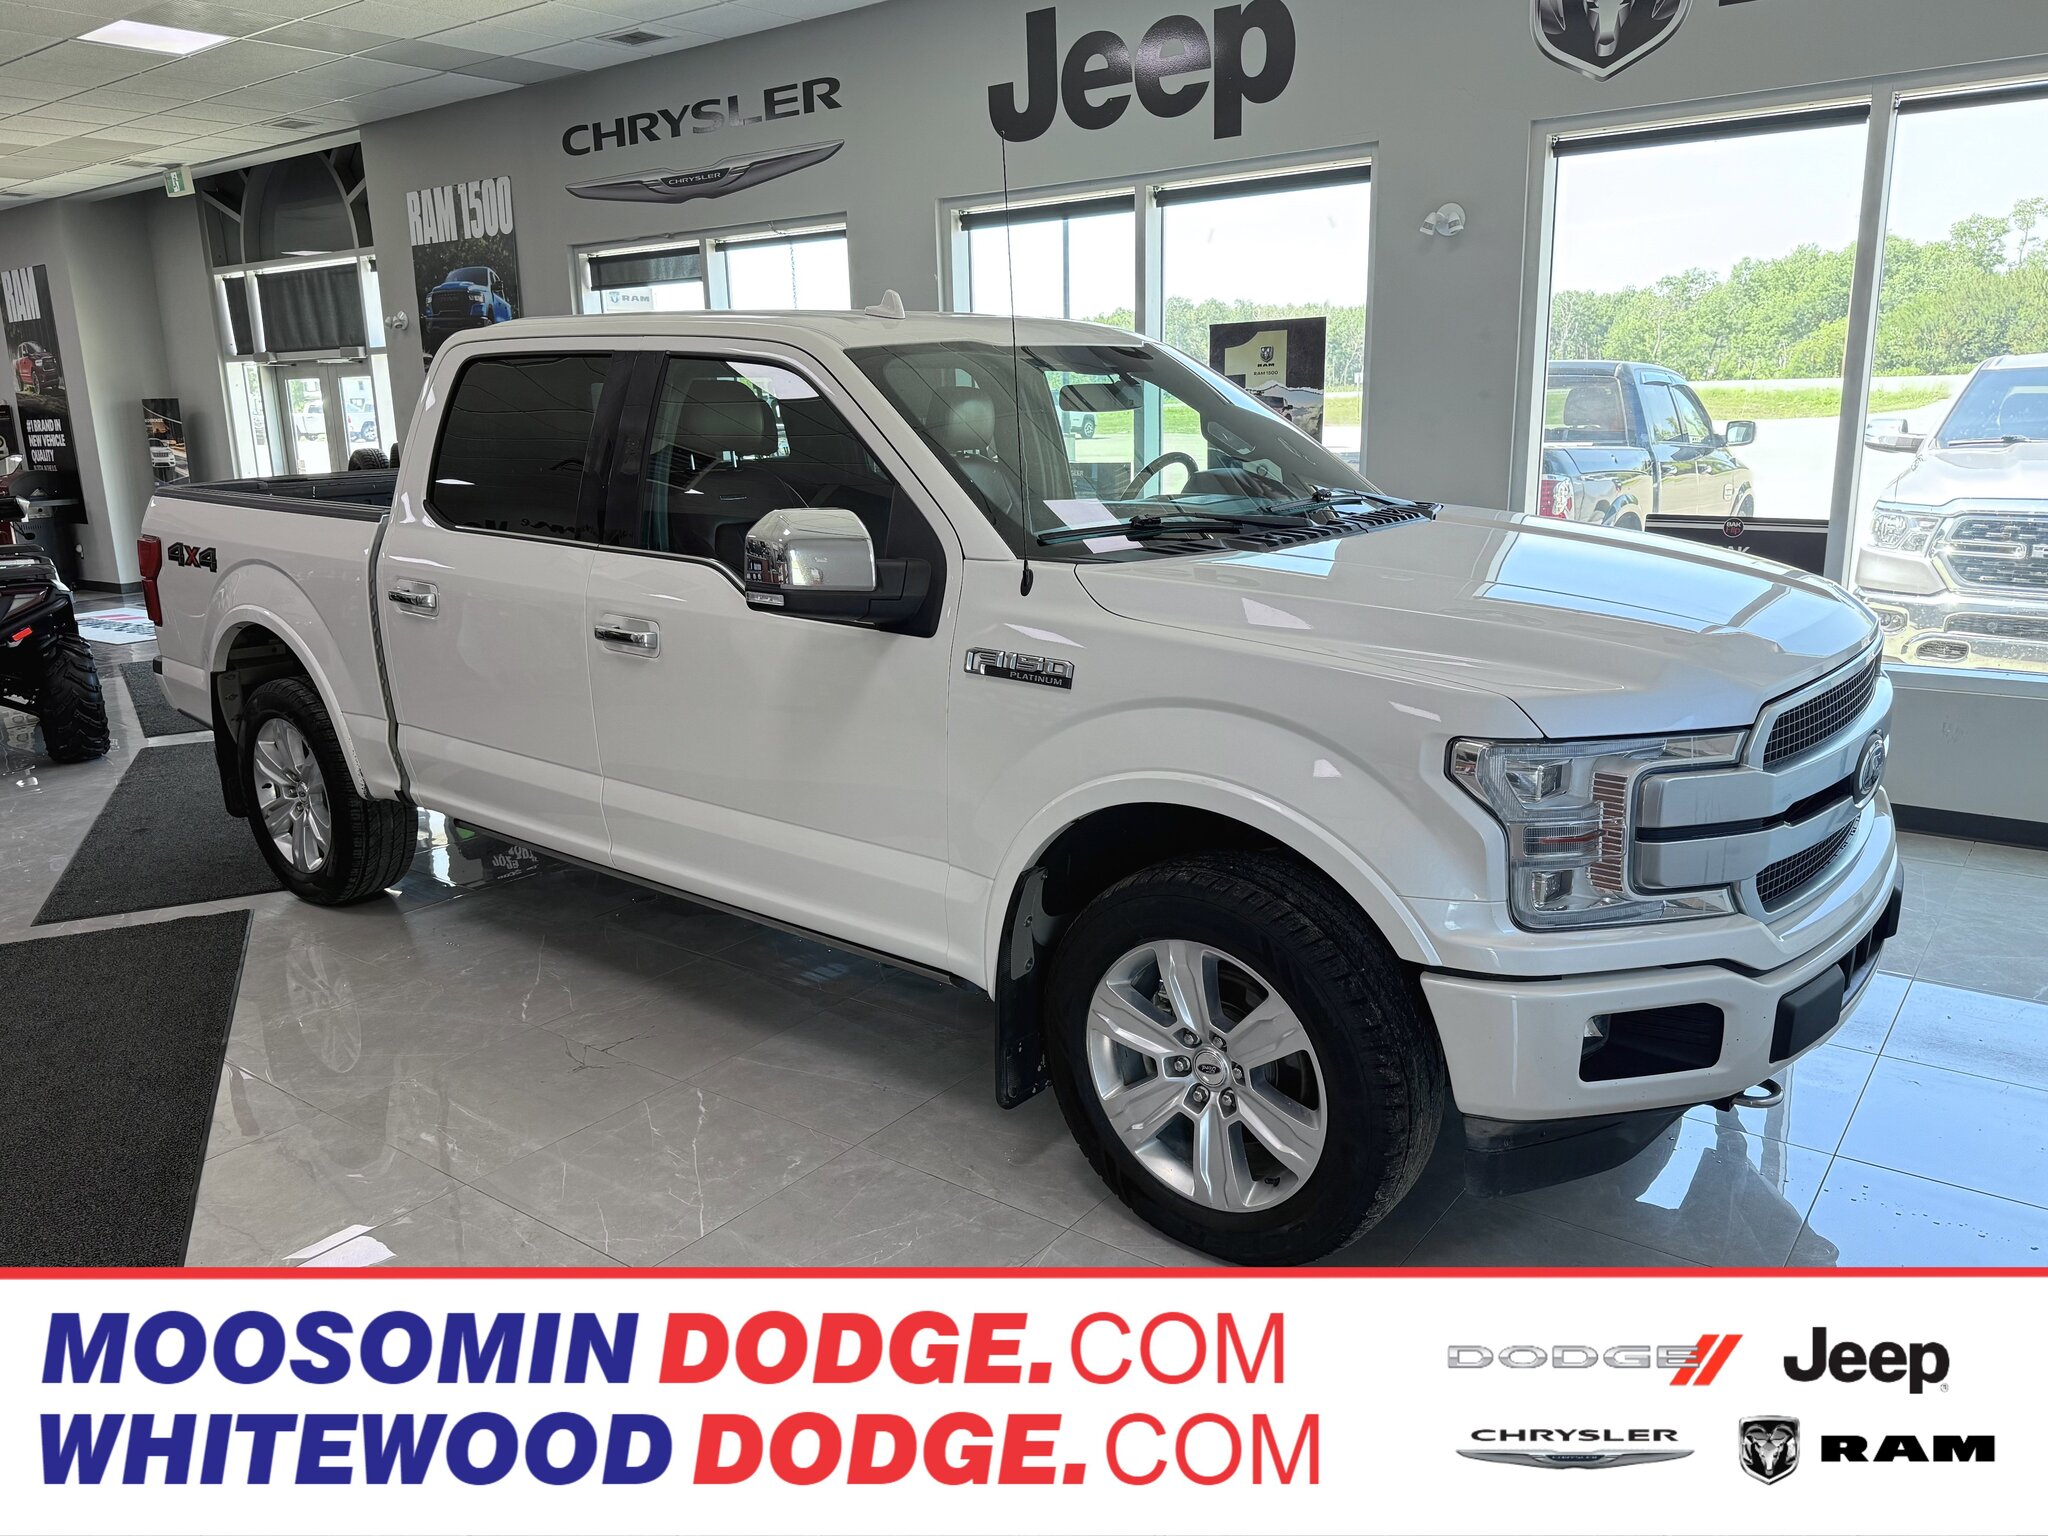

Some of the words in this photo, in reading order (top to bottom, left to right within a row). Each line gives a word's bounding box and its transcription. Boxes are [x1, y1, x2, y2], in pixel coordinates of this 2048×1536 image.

[988, 0, 1296, 142] Jeep
[562, 77, 843, 156] CHRYSLER
[668, 172, 722, 186] CHRYSLER
[406, 185, 458, 246] RAM
[457, 176, 514, 240] 1500
[1, 266, 41, 323] RAM
[622, 295, 650, 303] RAM
[26, 419, 34, 432] #1
[33, 419, 54, 432] BRAND
[54, 419, 62, 431] IN
[28, 434, 42, 447] NEW
[42, 434, 67, 446] VEHICLE
[31, 449, 55, 464] QUALITY
[1010, 671, 1063, 686] PLATINUM
